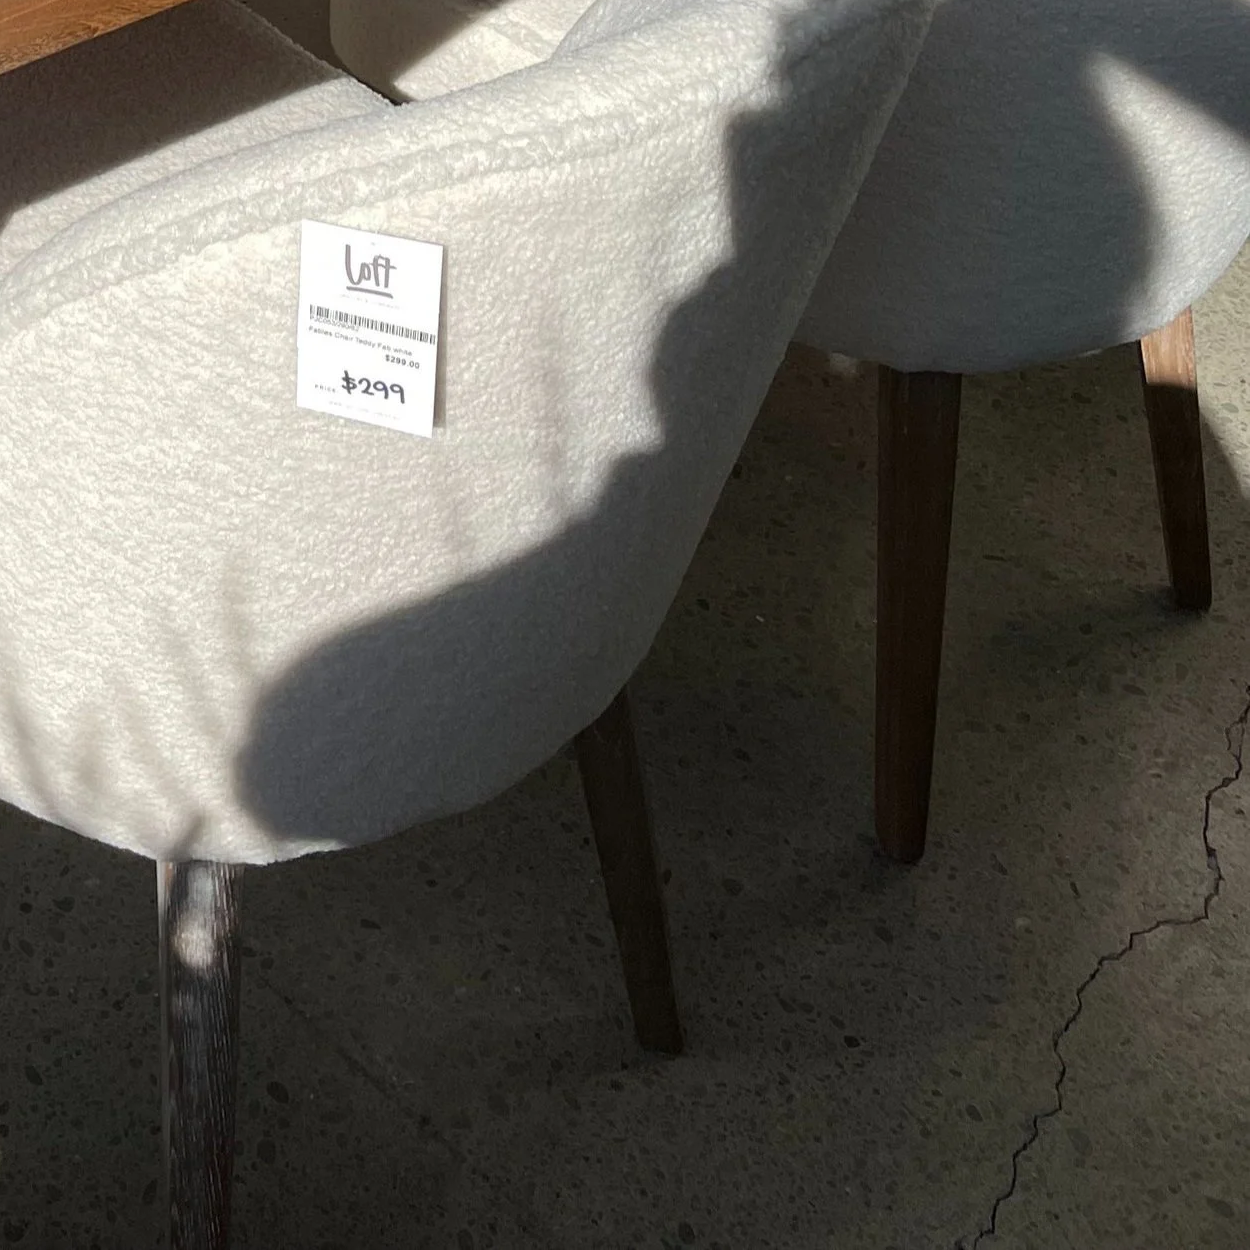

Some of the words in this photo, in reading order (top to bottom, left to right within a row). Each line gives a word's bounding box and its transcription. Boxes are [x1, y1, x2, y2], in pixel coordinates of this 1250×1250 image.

[345, 244, 397, 289] Loft
[334, 331, 354, 342] Chair
[355, 337, 376, 348] Teddy
[385, 354, 420, 369] $299.00
[341, 369, 405, 404] $299
